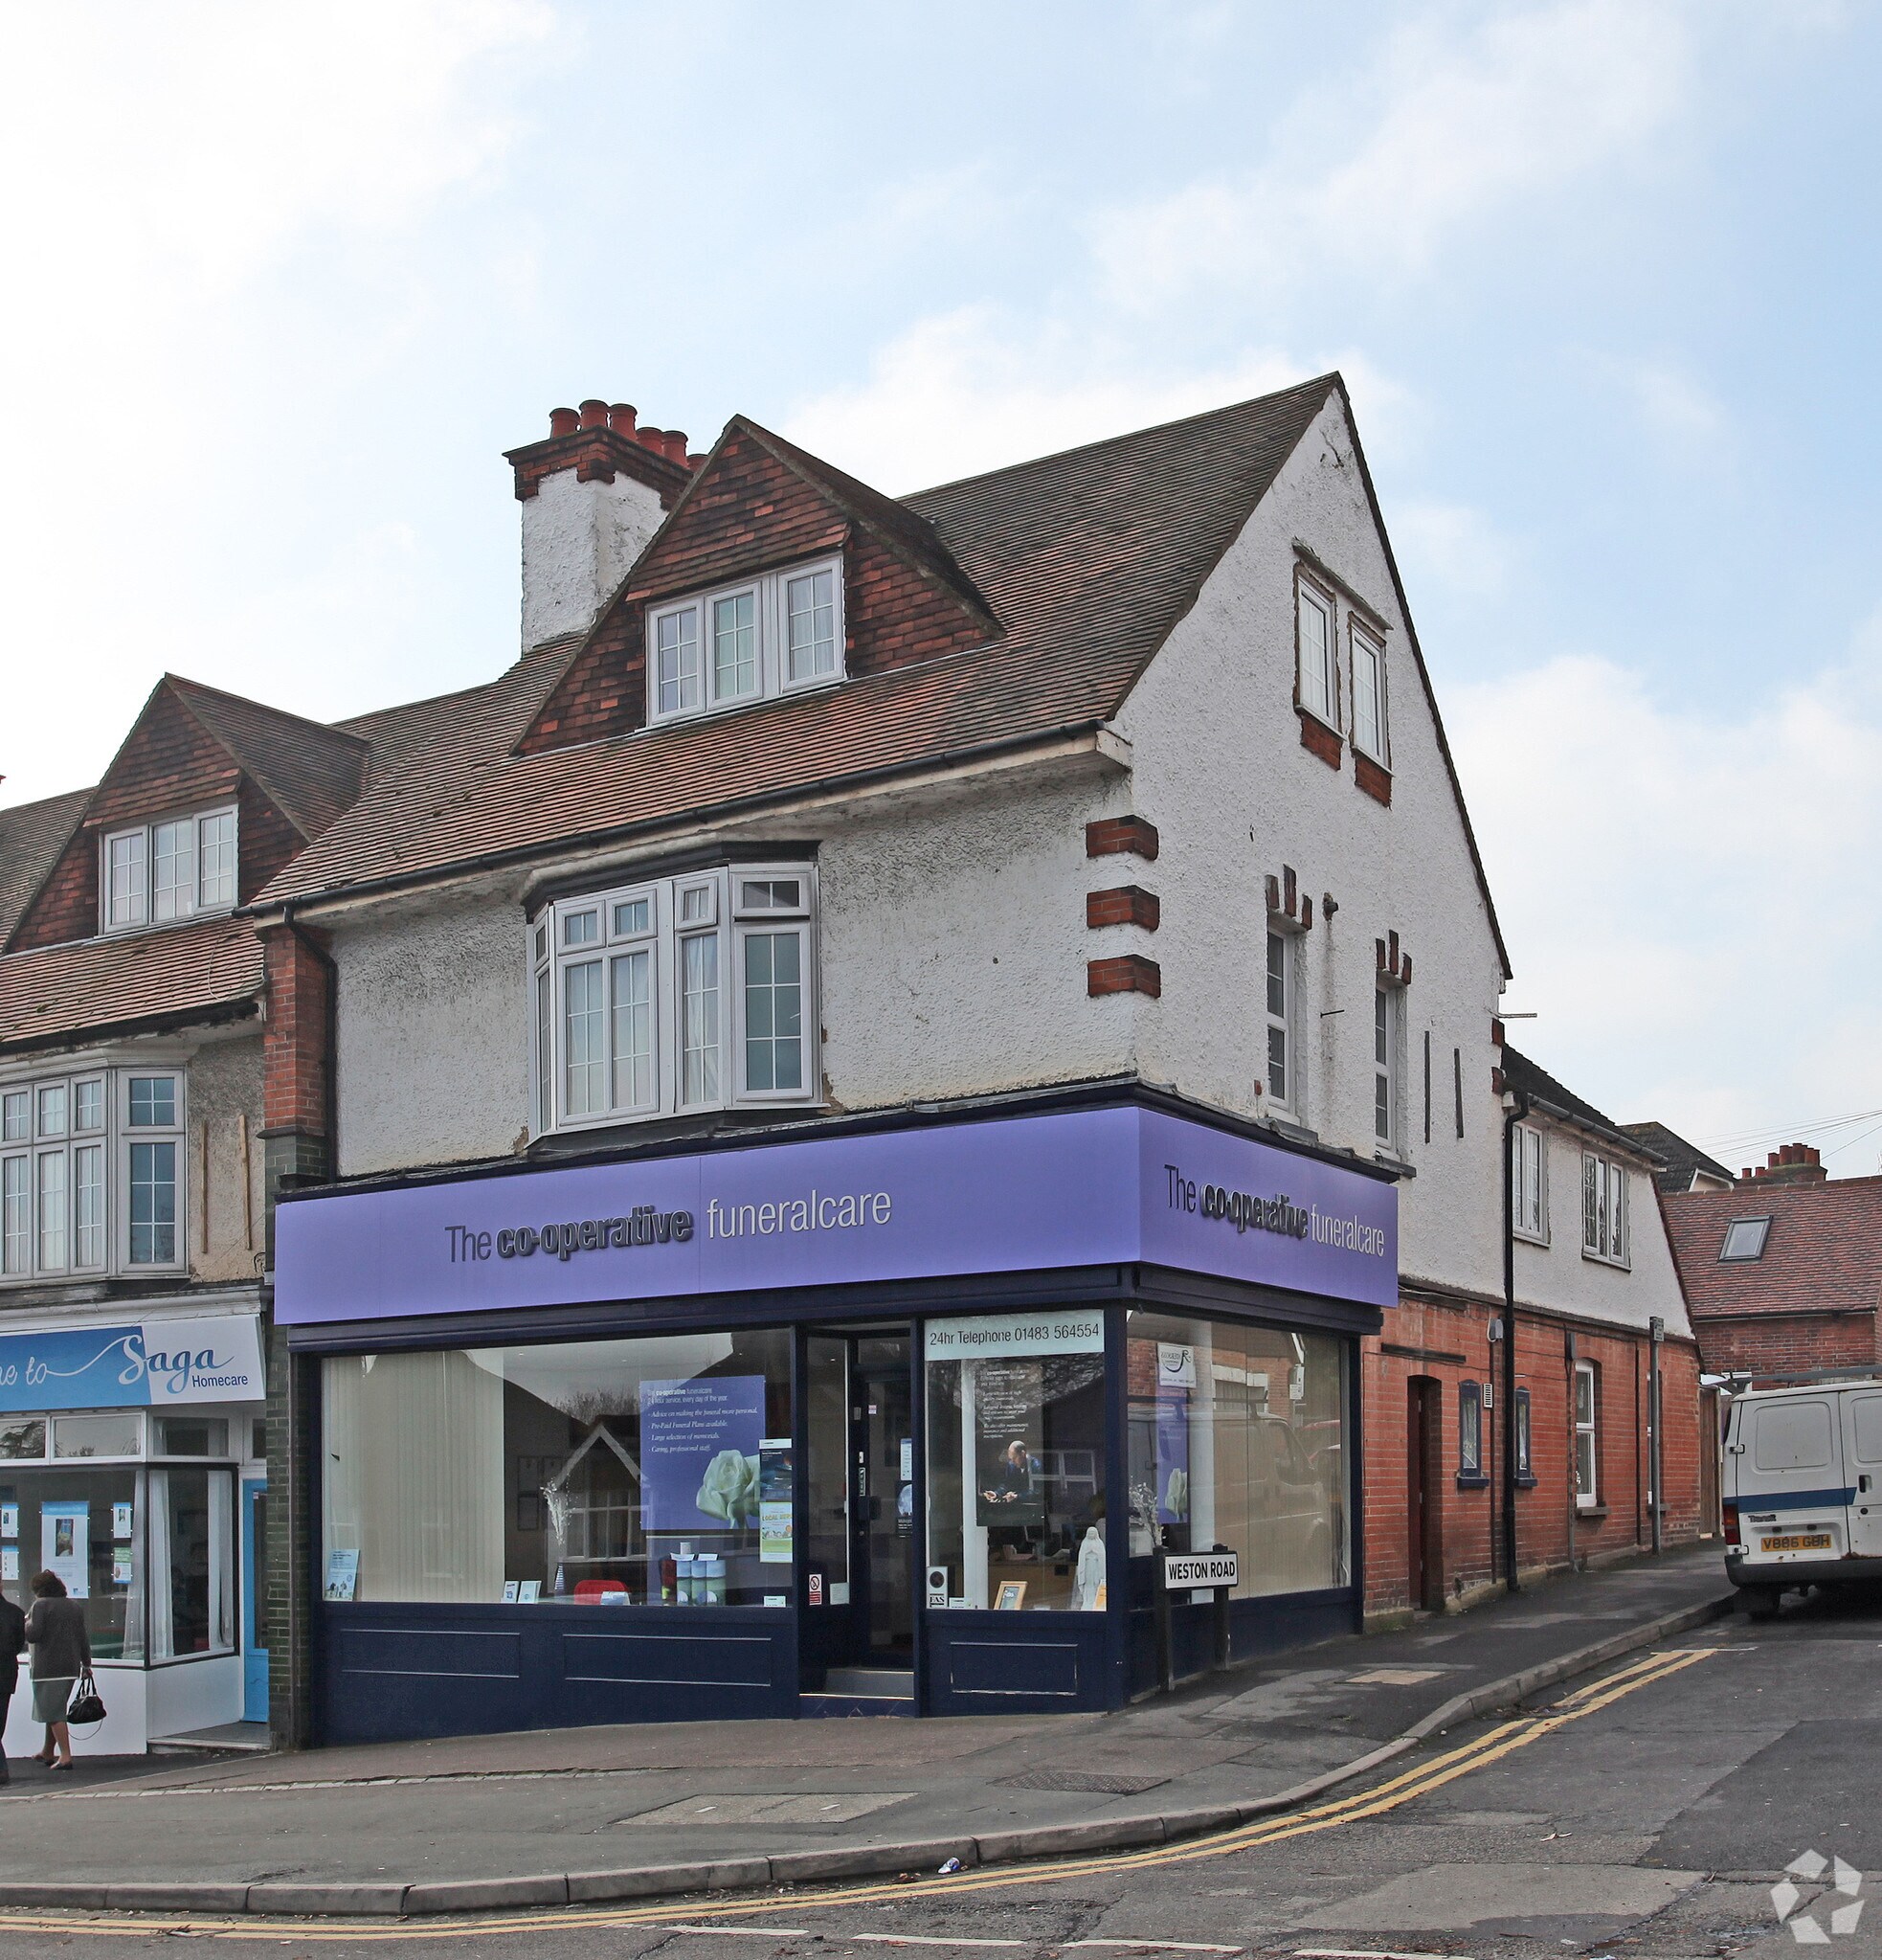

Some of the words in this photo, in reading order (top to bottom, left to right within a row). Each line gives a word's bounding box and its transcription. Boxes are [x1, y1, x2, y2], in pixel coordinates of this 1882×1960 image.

[445, 1226, 491, 1263] The
[496, 1205, 694, 1261] co-operative
[706, 1189, 892, 1239] funeralcare
[1164, 1164, 1196, 1212] The
[1199, 1183, 1309, 1240] co-operative
[1311, 1204, 1384, 1256] funeralcare
[930, 1332, 954, 1345] 24hr
[958, 1330, 1011, 1345] Telephone
[1015, 1326, 1049, 1340] 01483
[1054, 1323, 1099, 1339] 564554
[26, 1356, 47, 1386] to
[118, 1334, 235, 1394] Saga
[191, 1375, 248, 1388] Homecare
[1168, 1563, 1208, 1580] WESTON
[1210, 1561, 1236, 1578] ROAD
